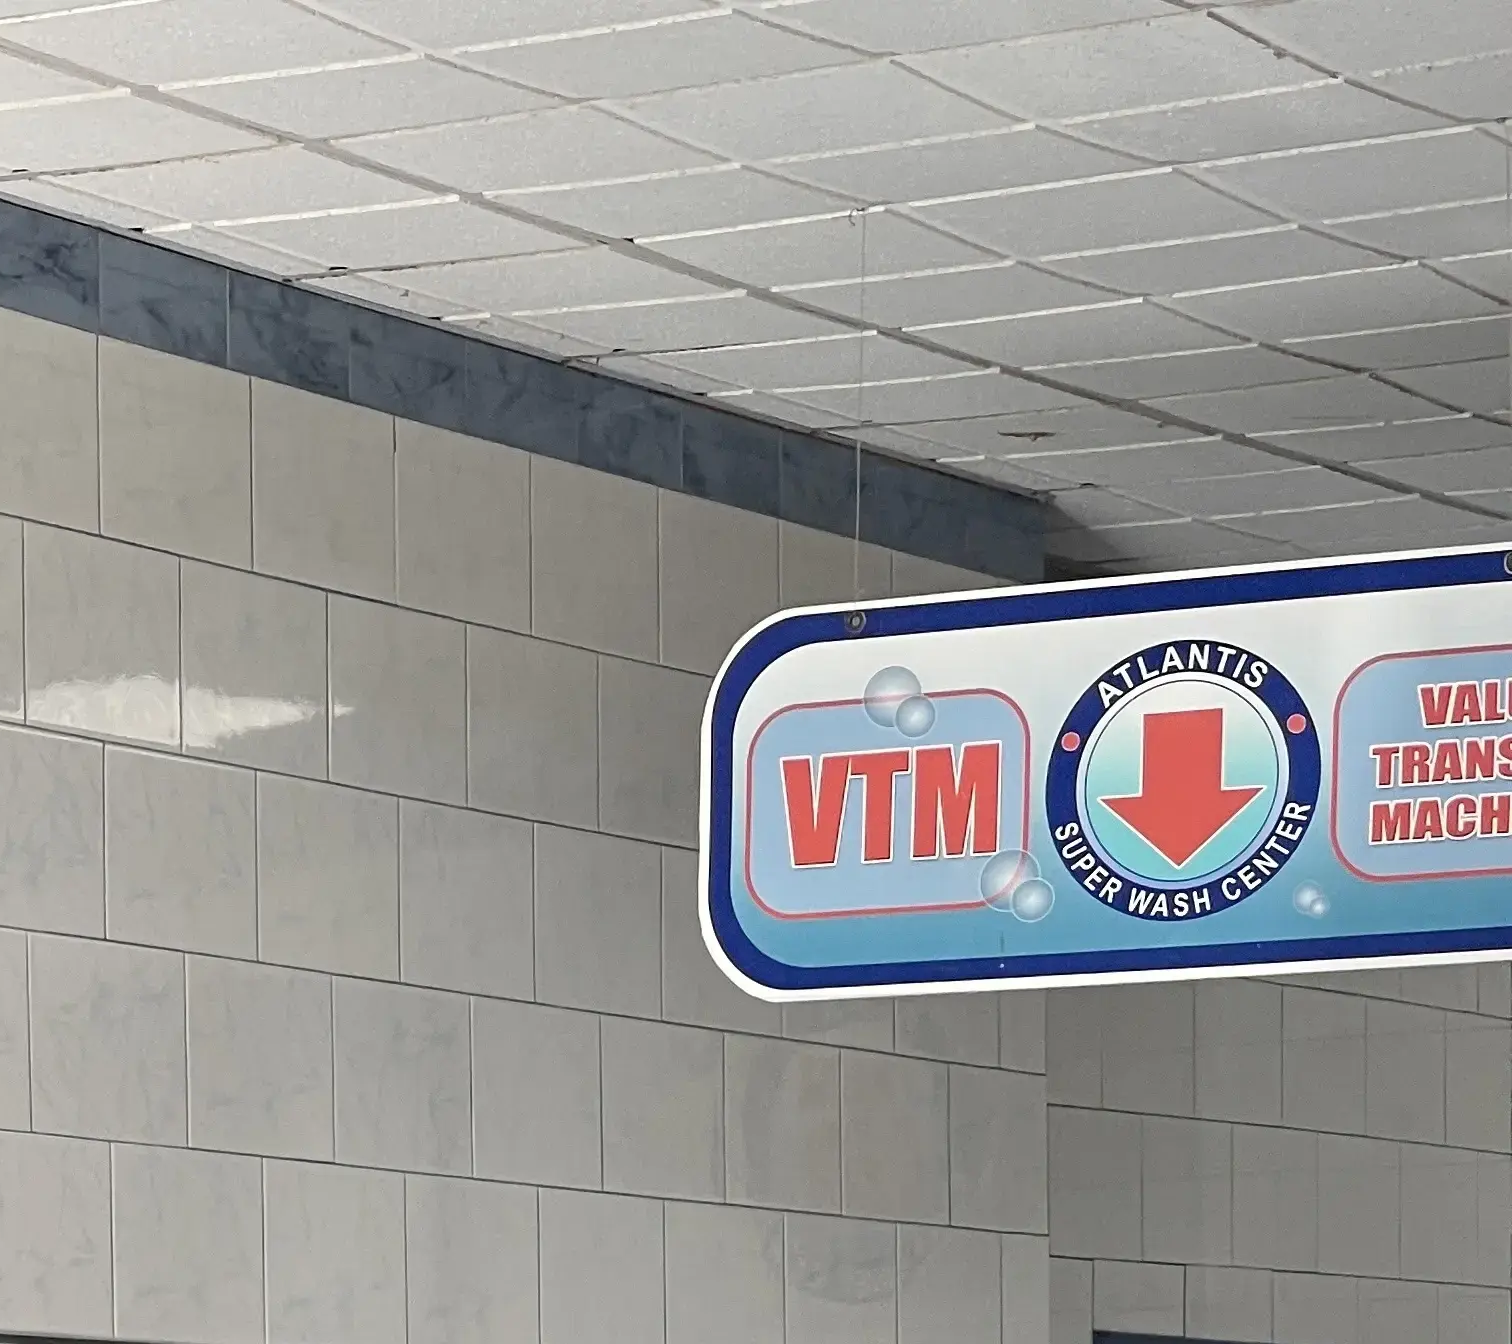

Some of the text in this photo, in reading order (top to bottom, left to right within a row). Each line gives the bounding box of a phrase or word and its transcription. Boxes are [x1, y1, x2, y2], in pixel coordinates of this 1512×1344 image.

[1096, 643, 1269, 709] ATLANTIS
[1417, 679, 1512, 728] VAL
[780, 739, 1002, 869] VTM
[1368, 791, 1512, 846] MACH
[1055, 801, 1311, 917] SUPER WASH CENTER
